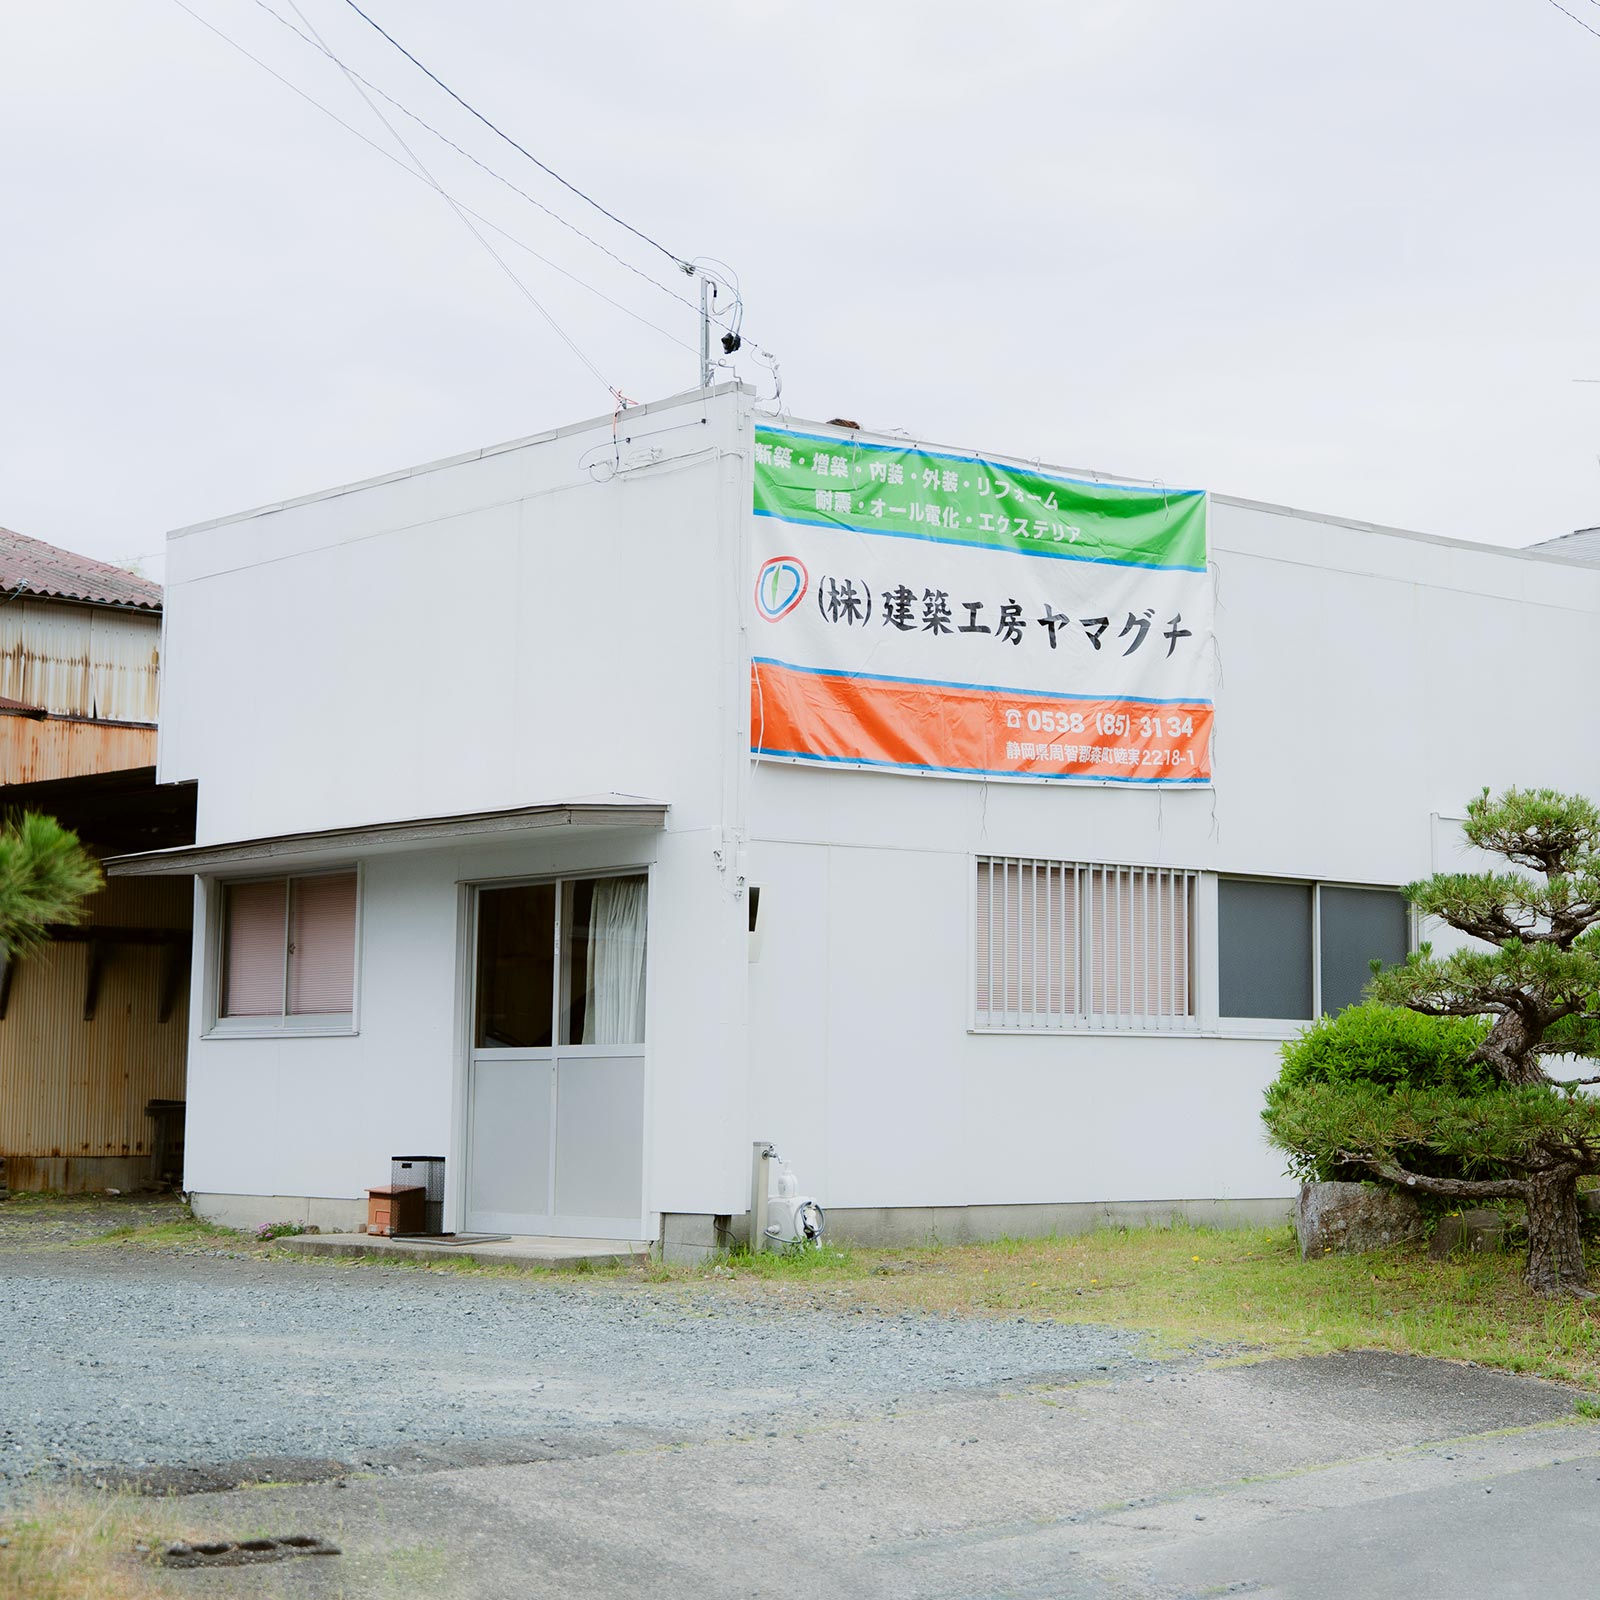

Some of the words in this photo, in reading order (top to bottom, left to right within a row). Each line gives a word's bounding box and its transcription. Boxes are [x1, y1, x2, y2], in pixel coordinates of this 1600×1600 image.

[818, 575, 1193, 659] (株)建築工房ヤマグチ
[1027, 709, 1085, 733] 0538
[1095, 712, 1131, 737] (85)
[1006, 741, 1196, 766] 静岡県周智郡森町睦実2218-1
